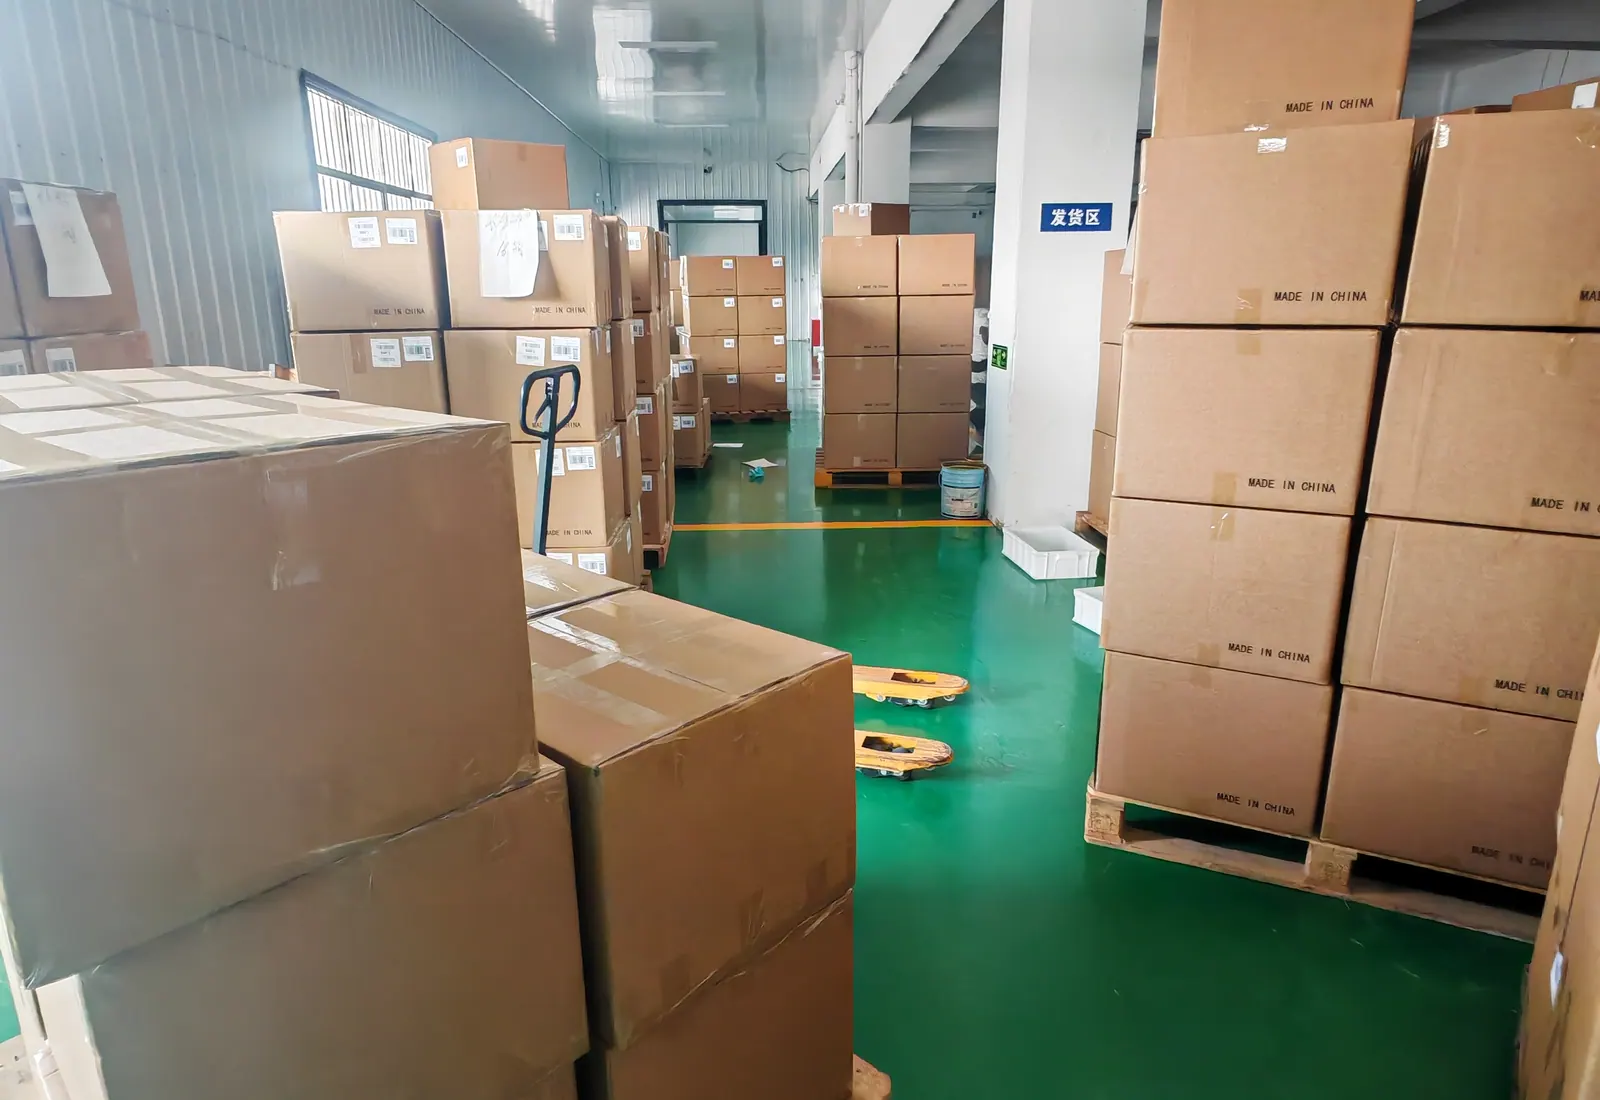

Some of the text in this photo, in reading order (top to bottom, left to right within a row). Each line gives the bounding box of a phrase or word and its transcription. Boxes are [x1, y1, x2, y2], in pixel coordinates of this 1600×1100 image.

[1285, 97, 1374, 113] MADE IN CHINA
[1050, 208, 1101, 227] 发货区
[1273, 290, 1367, 302] MADE IN CHINA
[534, 306, 552, 314] MADE
[1248, 477, 1336, 494] MADE IN CHINA
[1530, 497, 1564, 510] MADE
[1573, 501, 1590, 512] IN
[1227, 642, 1310, 663] MADE IN CHINA
[1495, 679, 1527, 693] MADE
[1535, 685, 1550, 696] IN
[1216, 792, 1295, 816] MADE IN CHINA
[1509, 854, 1523, 864] IN
